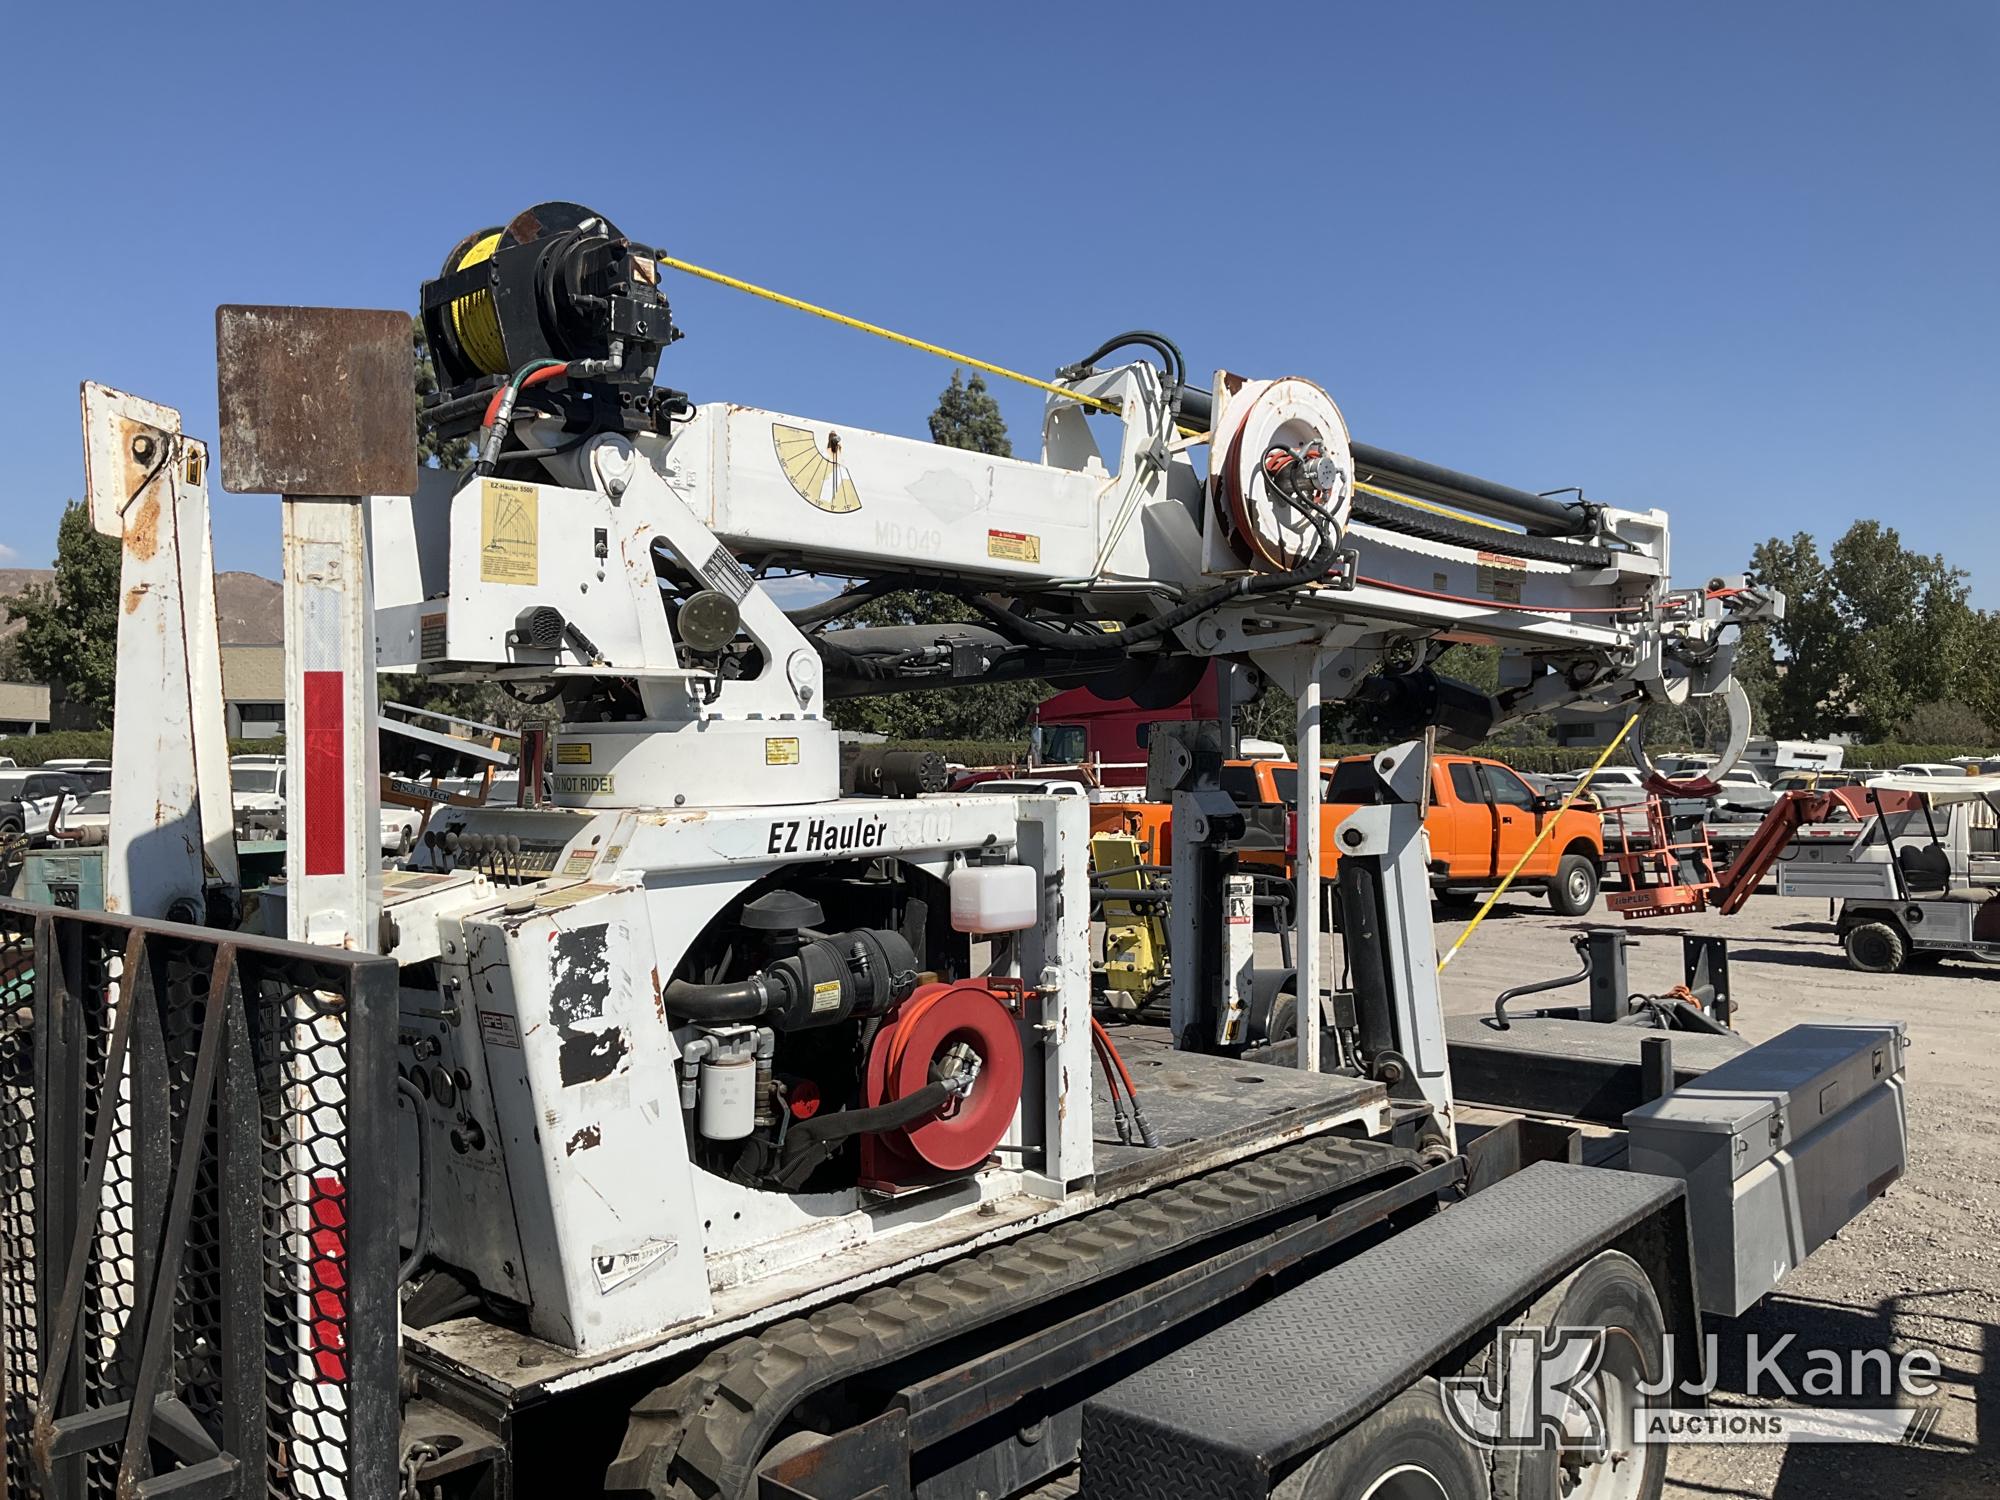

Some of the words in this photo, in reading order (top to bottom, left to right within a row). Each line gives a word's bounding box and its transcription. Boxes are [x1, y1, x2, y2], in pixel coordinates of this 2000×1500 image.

[561, 777, 577, 792] NOT
[580, 777, 613, 792] RIDE!
[768, 821, 801, 854] EZ
[806, 817, 888, 852] Hauler
